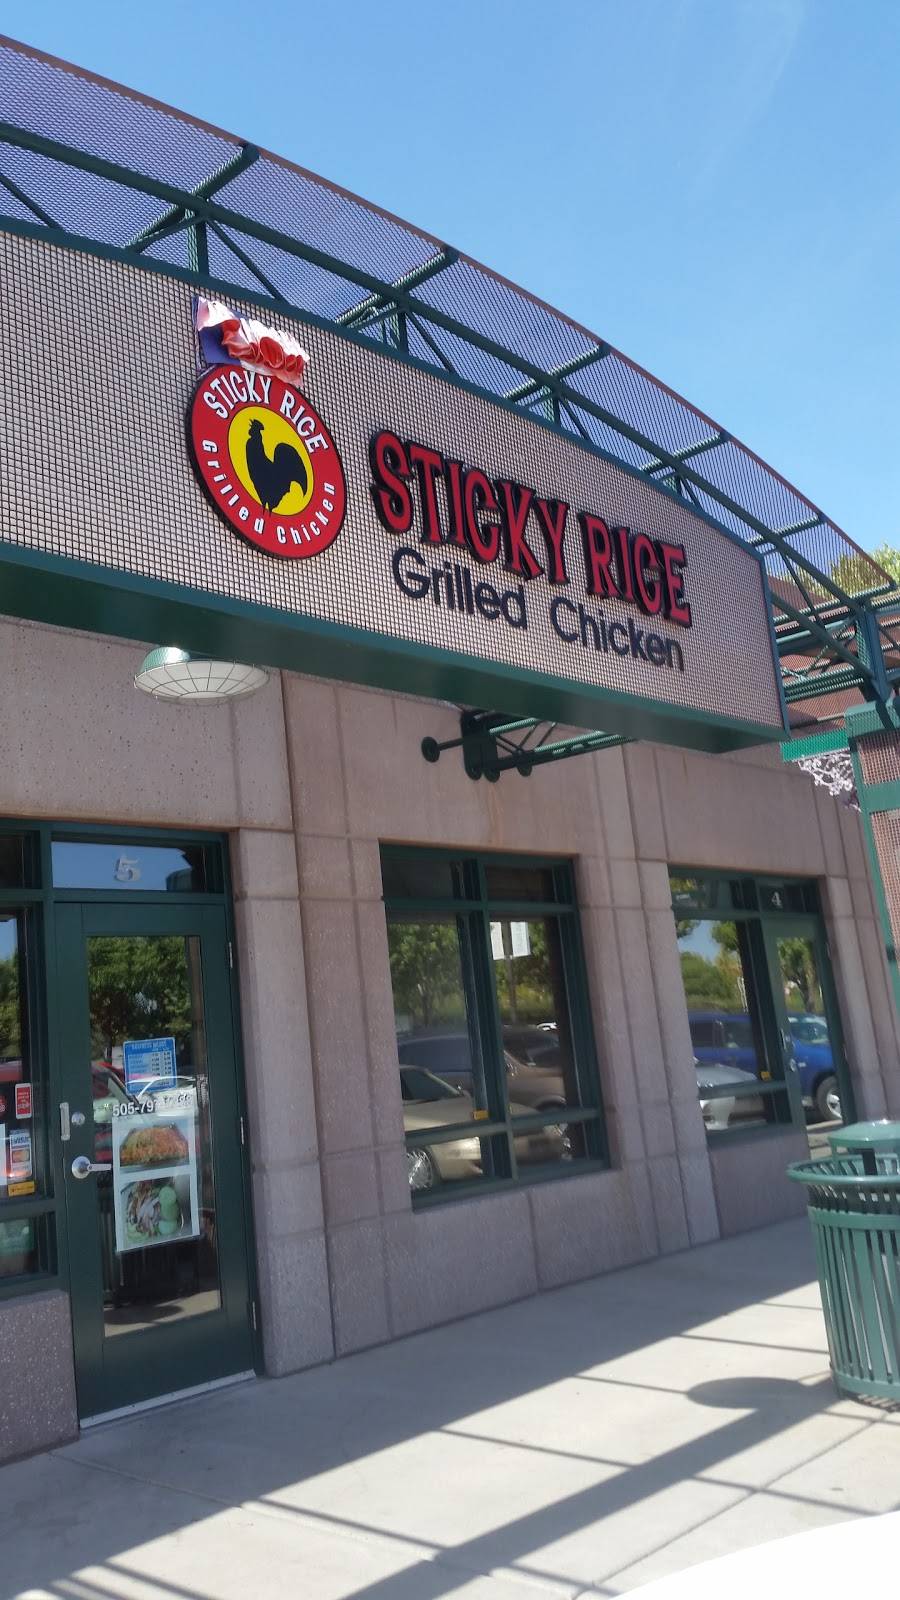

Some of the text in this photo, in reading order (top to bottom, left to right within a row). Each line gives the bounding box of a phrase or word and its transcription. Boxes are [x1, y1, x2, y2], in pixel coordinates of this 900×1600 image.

[203, 369, 329, 453] STICKY RICE
[202, 439, 335, 544] Grilled Chicken
[370, 430, 693, 628] STICKY RICE
[392, 547, 685, 672] Grilled Chicken
[114, 855, 141, 882] 5
[771, 891, 783, 907] 4
